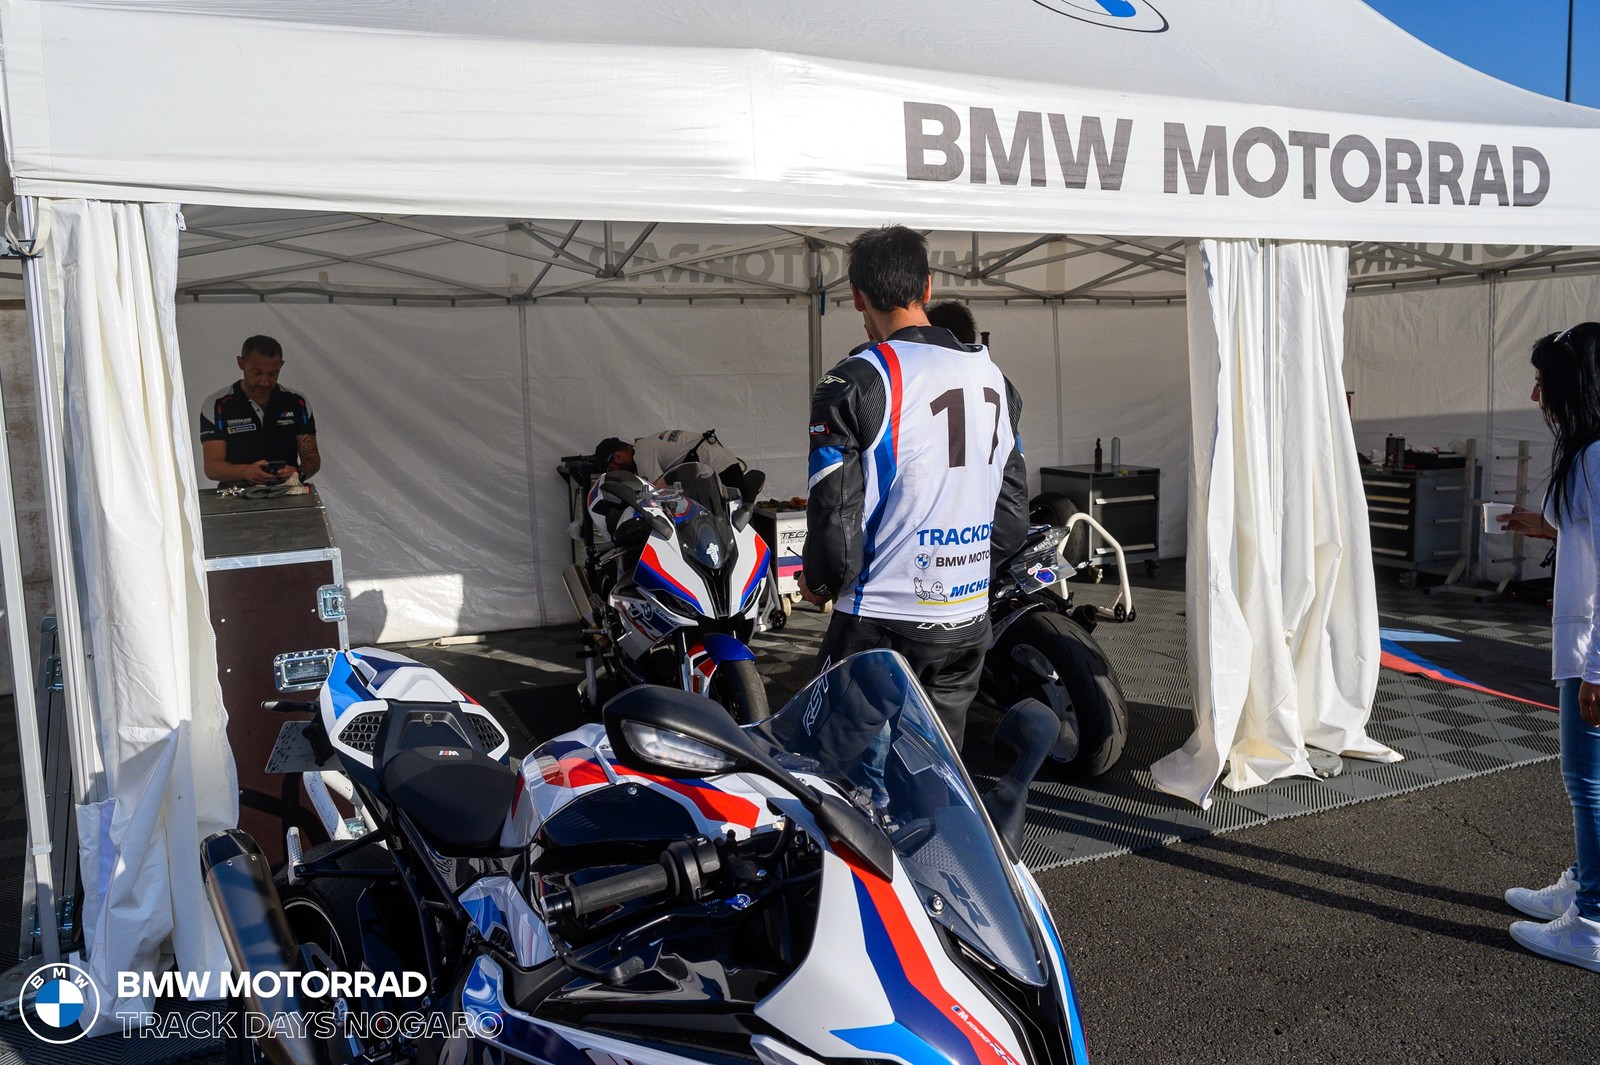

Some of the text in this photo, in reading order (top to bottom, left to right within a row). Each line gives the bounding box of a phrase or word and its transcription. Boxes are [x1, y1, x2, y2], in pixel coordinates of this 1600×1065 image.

[903, 101, 1550, 207] BMW MOTORRAD
[929, 386, 1000, 468] 17
[781, 530, 807, 539] TEC
[935, 555, 967, 567] BMW
[950, 578, 990, 598] MICHE
[938, 870, 991, 930] RR
